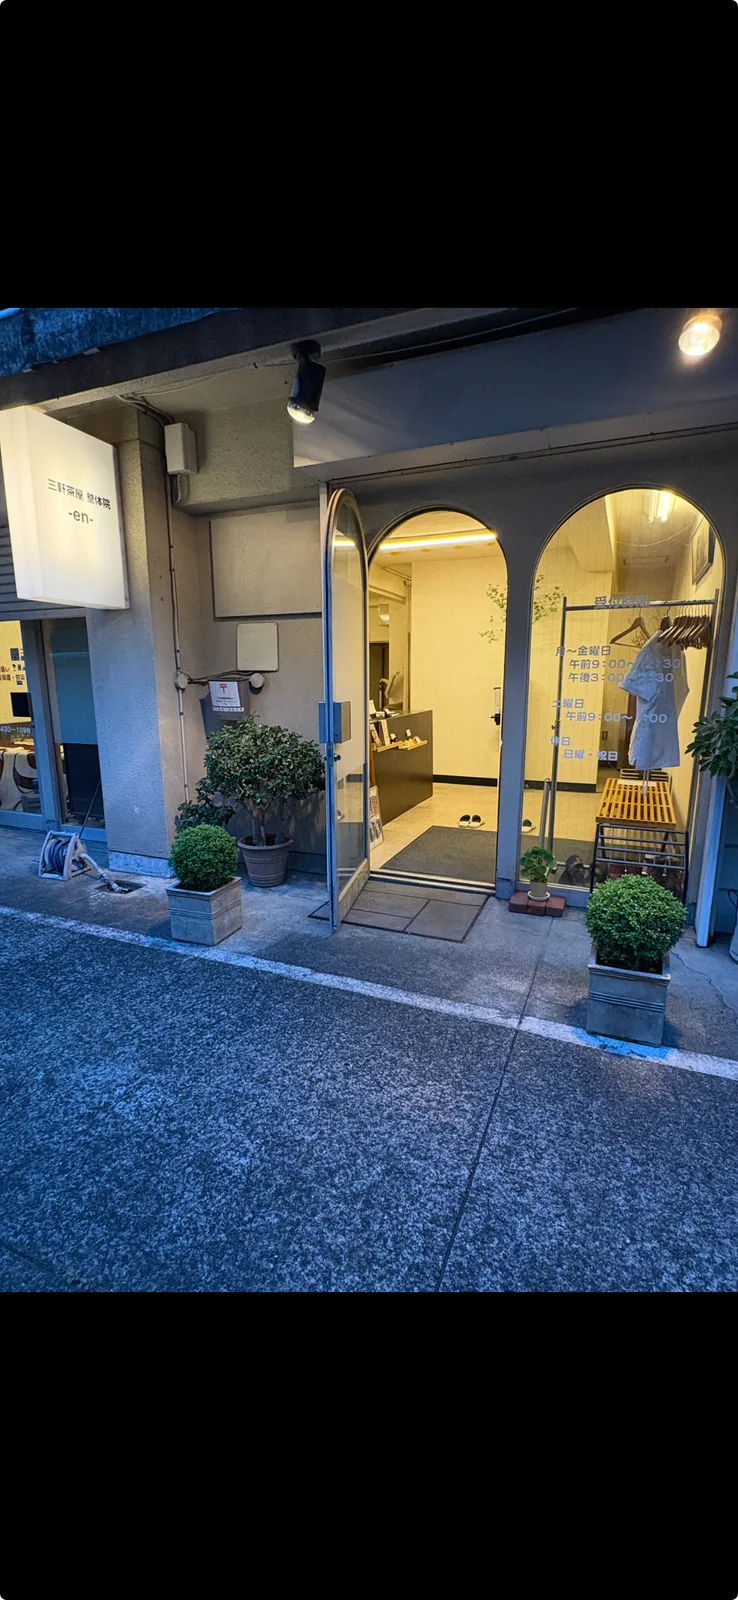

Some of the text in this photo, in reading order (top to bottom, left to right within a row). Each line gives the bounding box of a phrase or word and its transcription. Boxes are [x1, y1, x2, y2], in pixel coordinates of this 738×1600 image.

[47, 478, 111, 510] 三軒茶屋 整体院
[564, 749, 618, 761] 日曜・祝日
